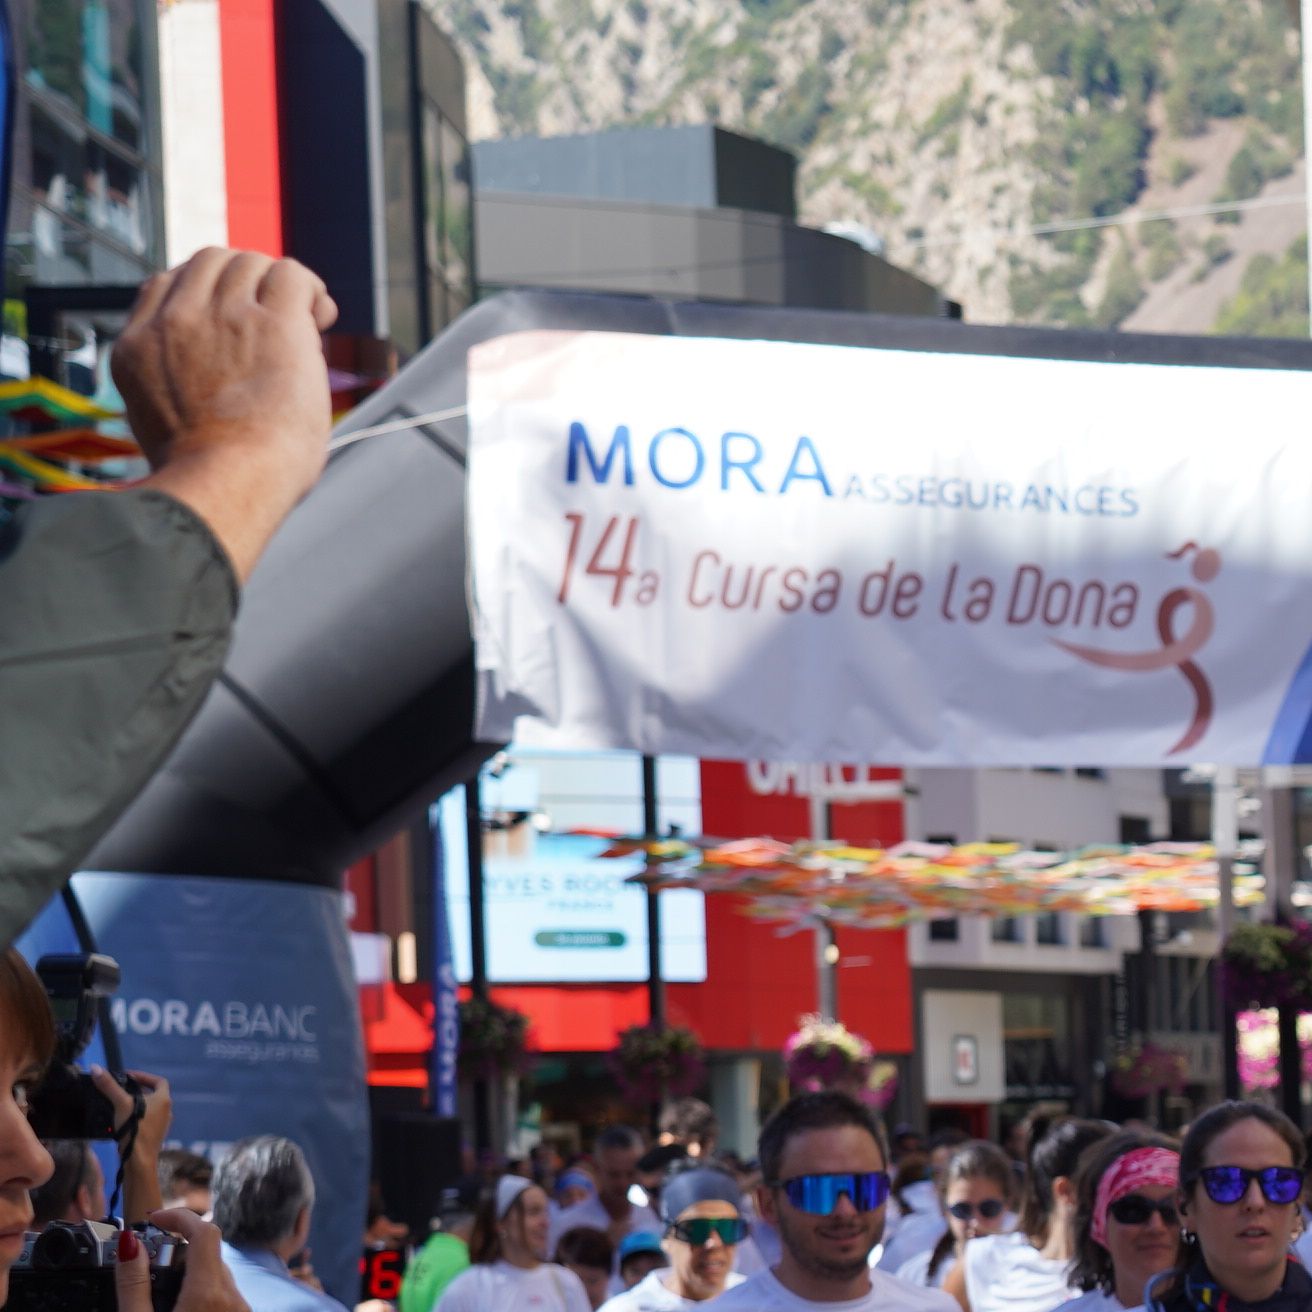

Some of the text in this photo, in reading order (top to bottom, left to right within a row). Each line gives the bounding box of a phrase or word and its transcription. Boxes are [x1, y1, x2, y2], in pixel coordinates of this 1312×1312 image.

[566, 420, 1140, 518] MORA ASSEGURANCES
[688, 549, 843, 615] Cursa
[859, 559, 924, 620] de
[1007, 562, 1141, 630] Dona
